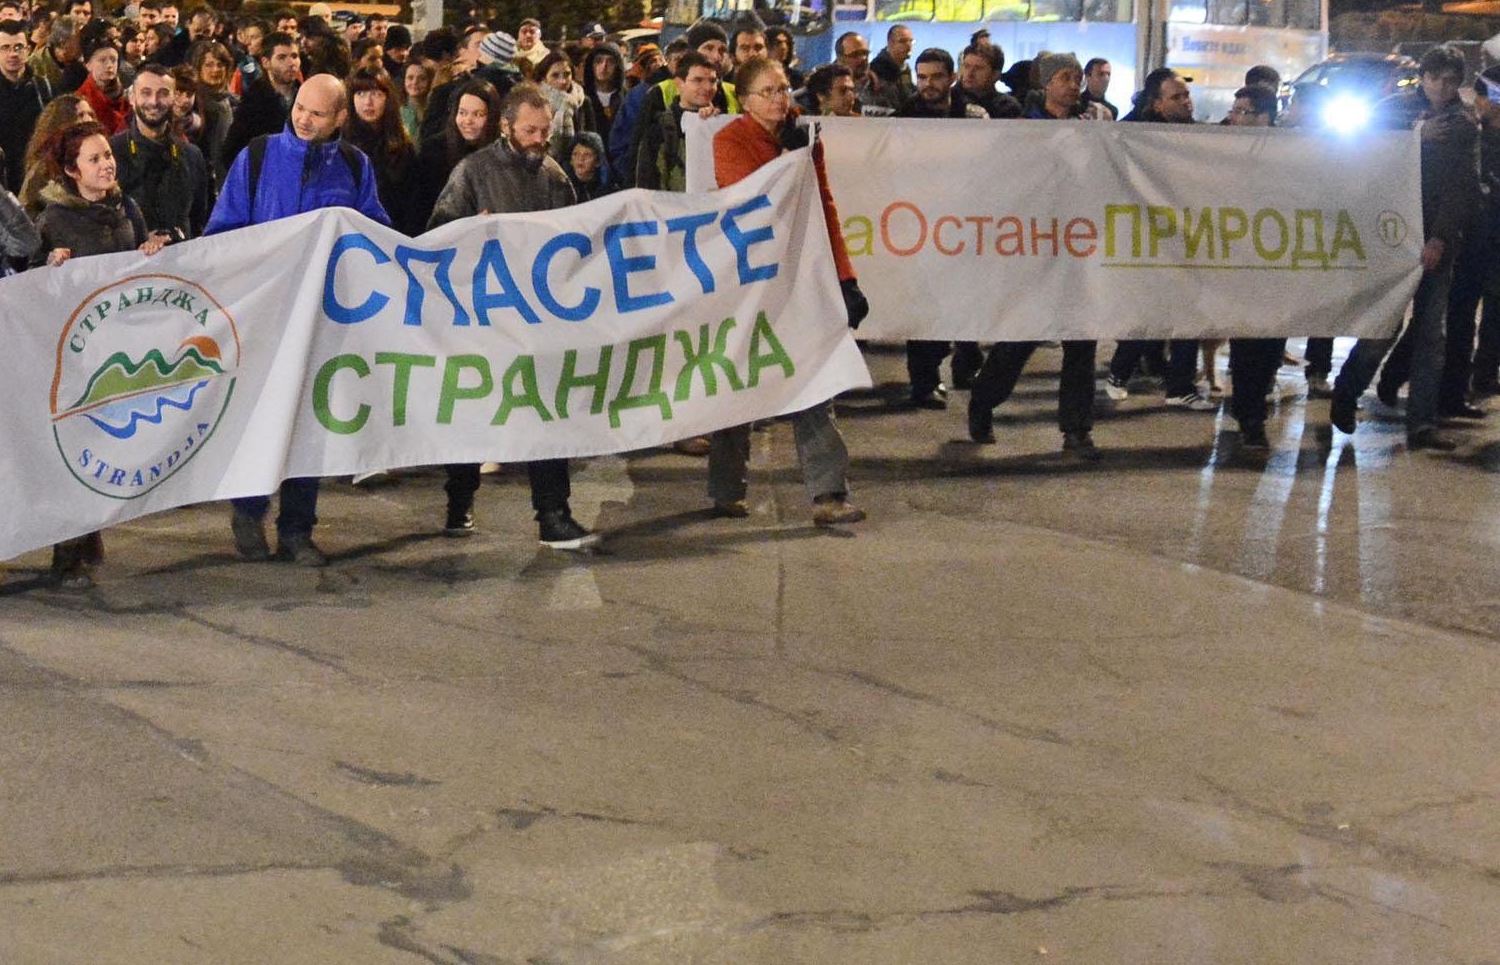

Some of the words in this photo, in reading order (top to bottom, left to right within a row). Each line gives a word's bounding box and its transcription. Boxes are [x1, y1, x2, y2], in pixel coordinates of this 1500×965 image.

[322, 194, 780, 327] СПАСЕТЕ
[69, 286, 209, 354] СТРАНДЖА
[311, 311, 796, 435] СТРАНДЖА
[78, 423, 210, 487] STRANDJA
